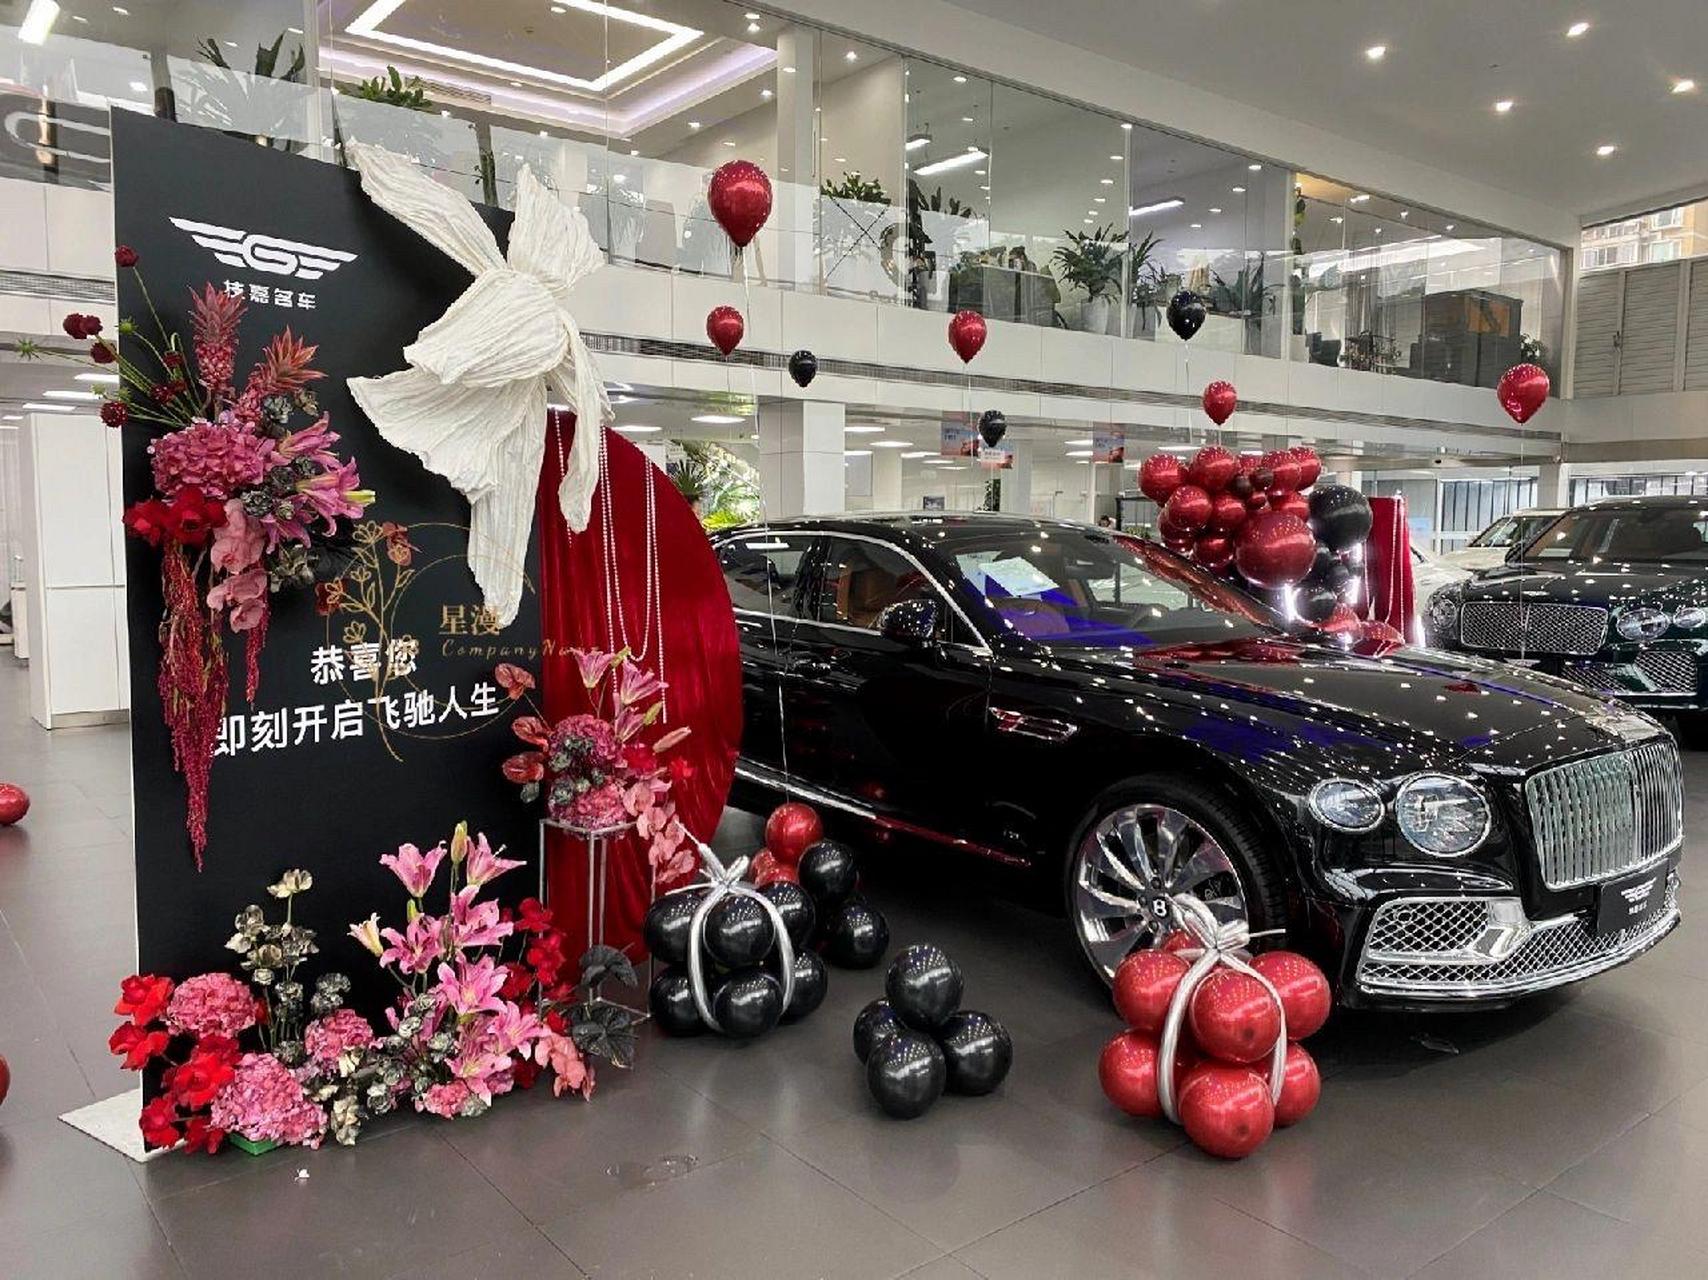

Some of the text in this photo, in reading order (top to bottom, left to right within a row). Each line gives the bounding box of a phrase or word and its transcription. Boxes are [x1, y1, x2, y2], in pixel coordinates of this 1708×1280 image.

[310, 638, 419, 686] 恭喜您
[214, 681, 500, 758] 即刻开启飞驰人生
